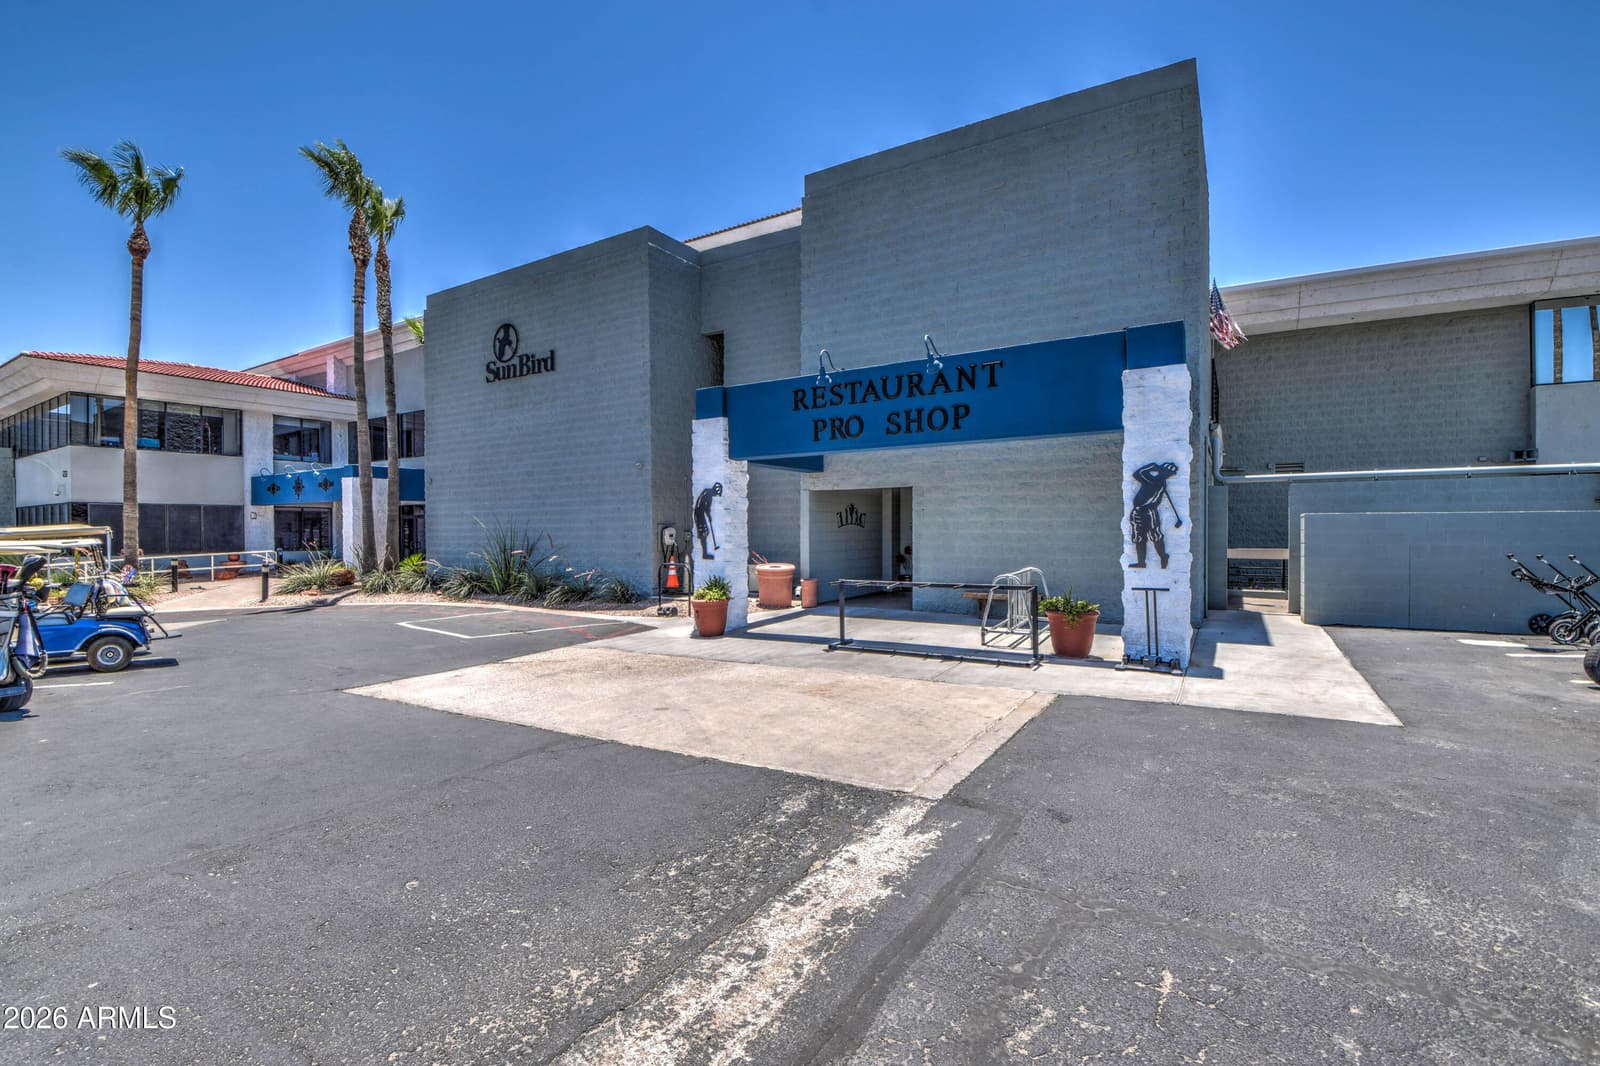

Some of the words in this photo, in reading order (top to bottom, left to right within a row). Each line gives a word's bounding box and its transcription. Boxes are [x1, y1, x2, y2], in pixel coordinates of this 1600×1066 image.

[485, 349, 555, 384] SunBird
[792, 360, 1004, 411] RESTAURANT
[812, 415, 864, 442] PRO
[886, 403, 971, 435] SHOP
